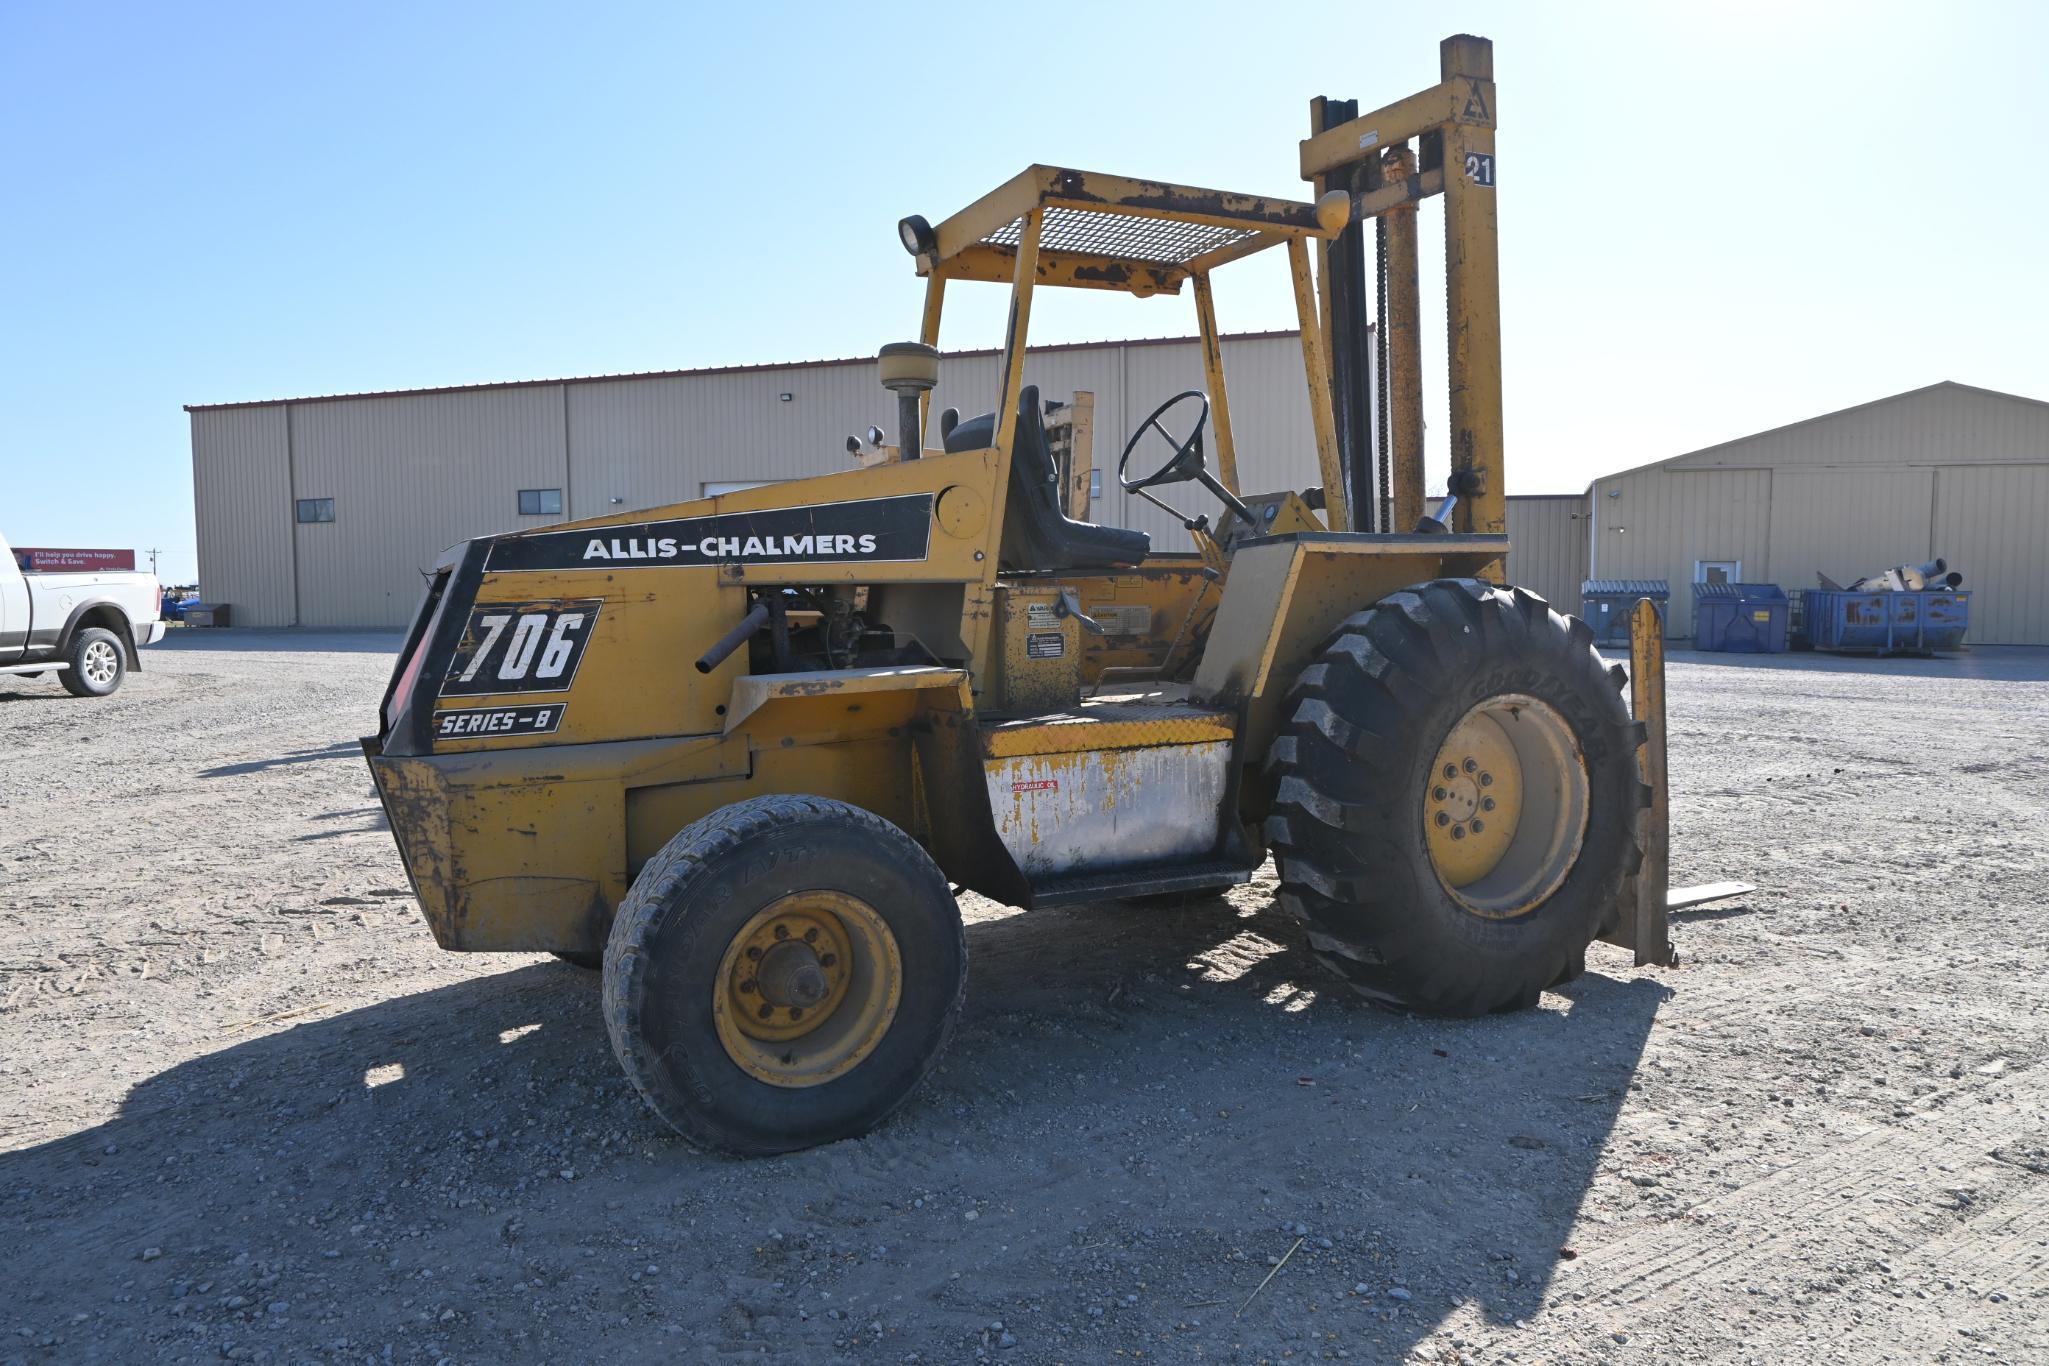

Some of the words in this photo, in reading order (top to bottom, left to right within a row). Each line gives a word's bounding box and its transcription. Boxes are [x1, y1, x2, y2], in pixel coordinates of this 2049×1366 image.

[1466, 156, 1491, 183] 21
[583, 534, 877, 560] ALLIS-CHALMERS
[457, 613, 585, 682] 706
[1012, 782, 1044, 790] HYDRAULIC
